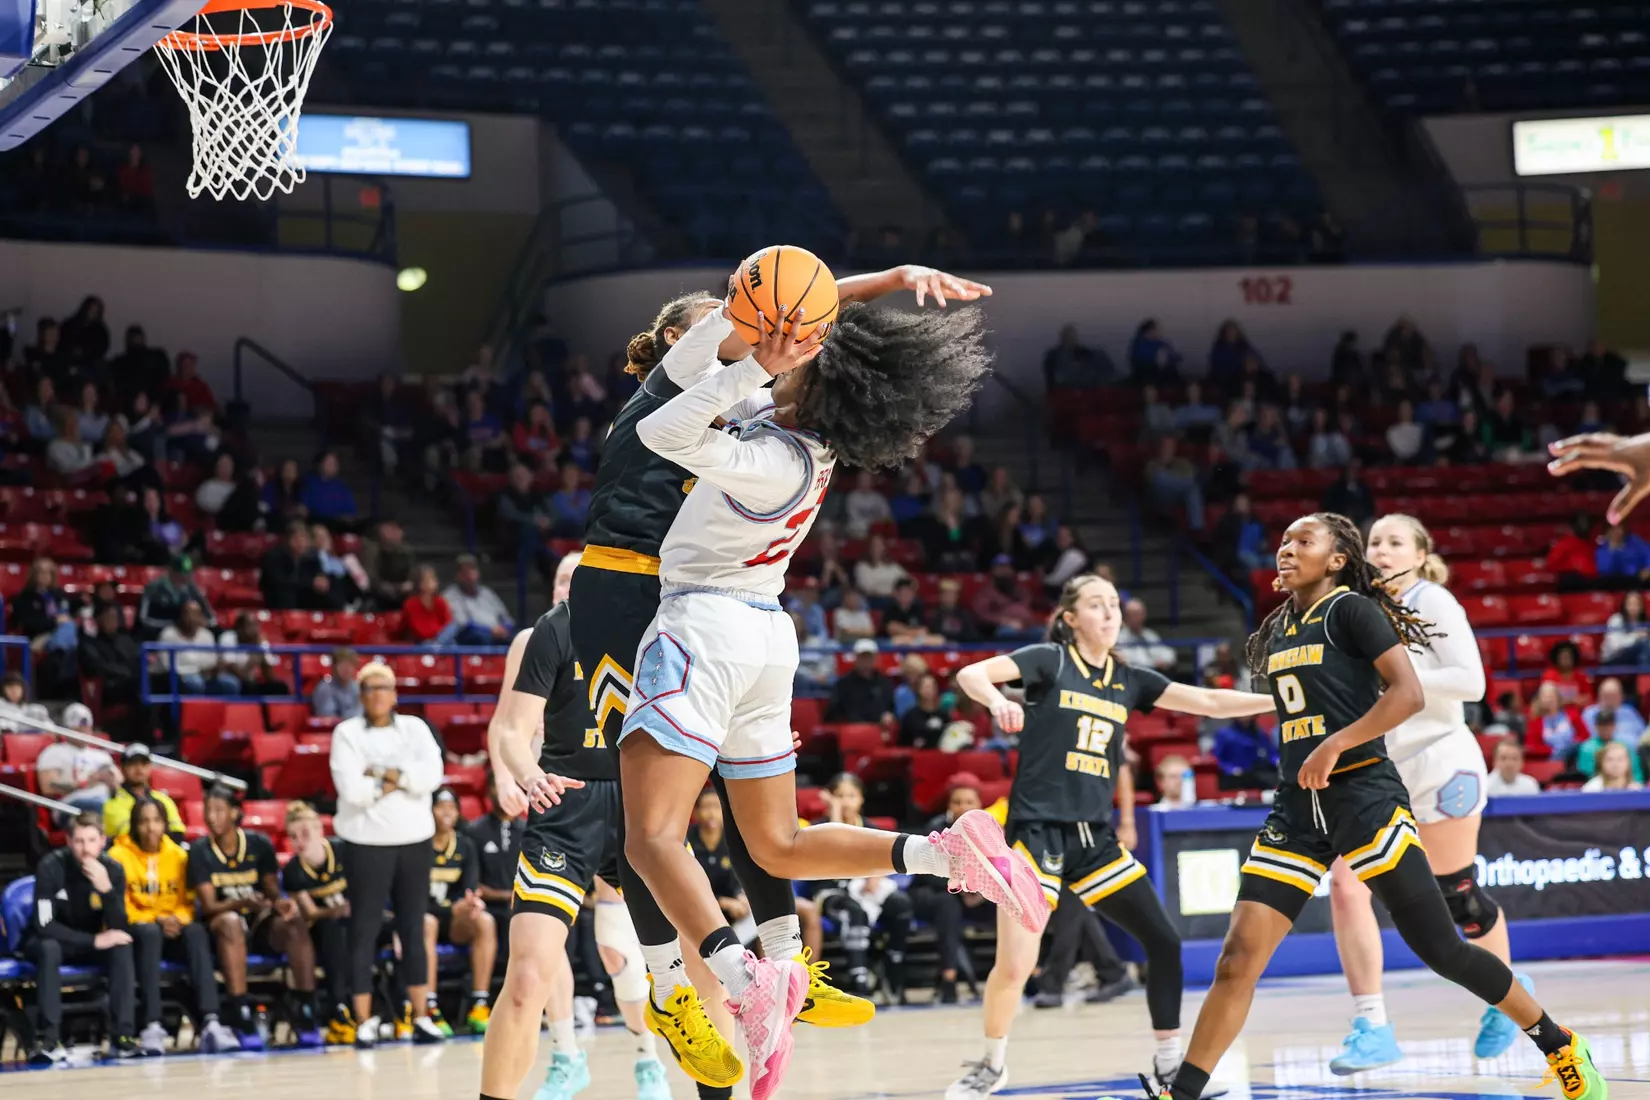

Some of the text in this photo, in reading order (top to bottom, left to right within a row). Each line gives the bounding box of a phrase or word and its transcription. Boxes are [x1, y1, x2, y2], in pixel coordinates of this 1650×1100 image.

[1238, 276, 1293, 305] 102
[1276, 673, 1307, 714] 0
[1076, 714, 1114, 755] 12
[1619, 846, 1642, 879] &
